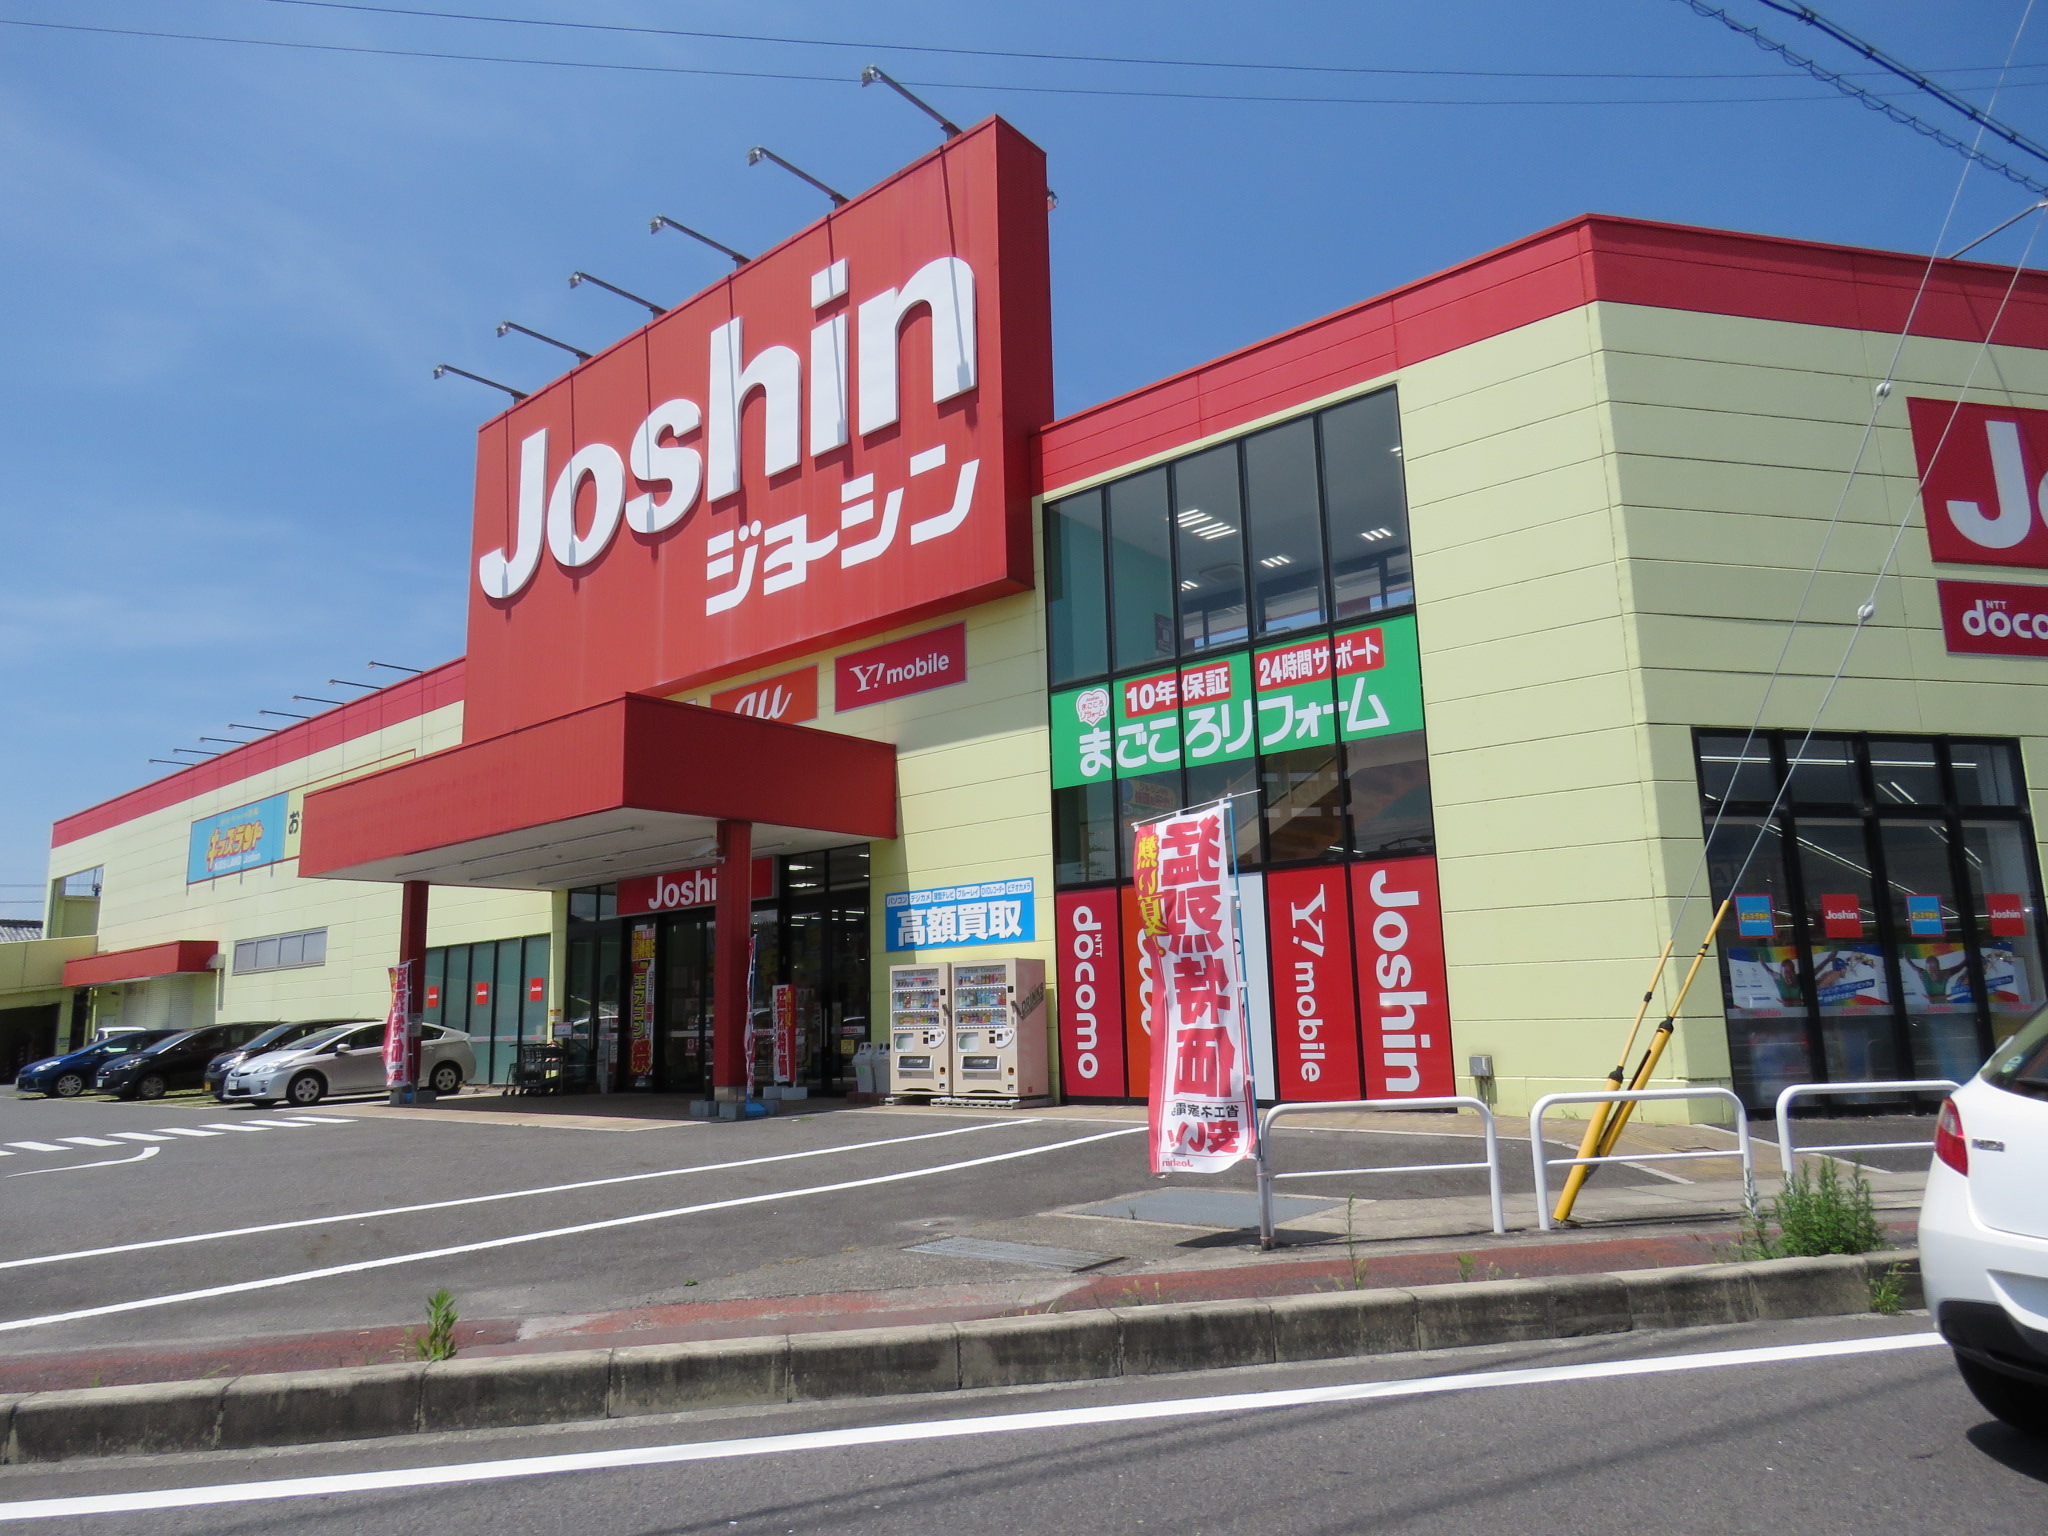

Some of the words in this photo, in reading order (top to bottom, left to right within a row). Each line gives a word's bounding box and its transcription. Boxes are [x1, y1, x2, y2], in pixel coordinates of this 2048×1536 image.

[479, 256, 977, 599] Joshin
[1946, 420, 2048, 549] J
[706, 444, 979, 616] ジョーシン
[1984, 600, 2006, 609] NTT
[1259, 637, 1380, 684] 24時間サポート
[1126, 669, 1230, 712] 10年保証
[1079, 676, 1390, 777] まごころリフォーム
[289, 811, 302, 835] お
[648, 868, 717, 910] Joshi
[897, 900, 1023, 947] 高額買取
[1826, 910, 1858, 920] Joshin
[1991, 909, 2020, 919] Joshin
[1094, 933, 1103, 958] NTT
[1073, 905, 1101, 1079] docomo
[1369, 869, 1430, 1092] Joshin
